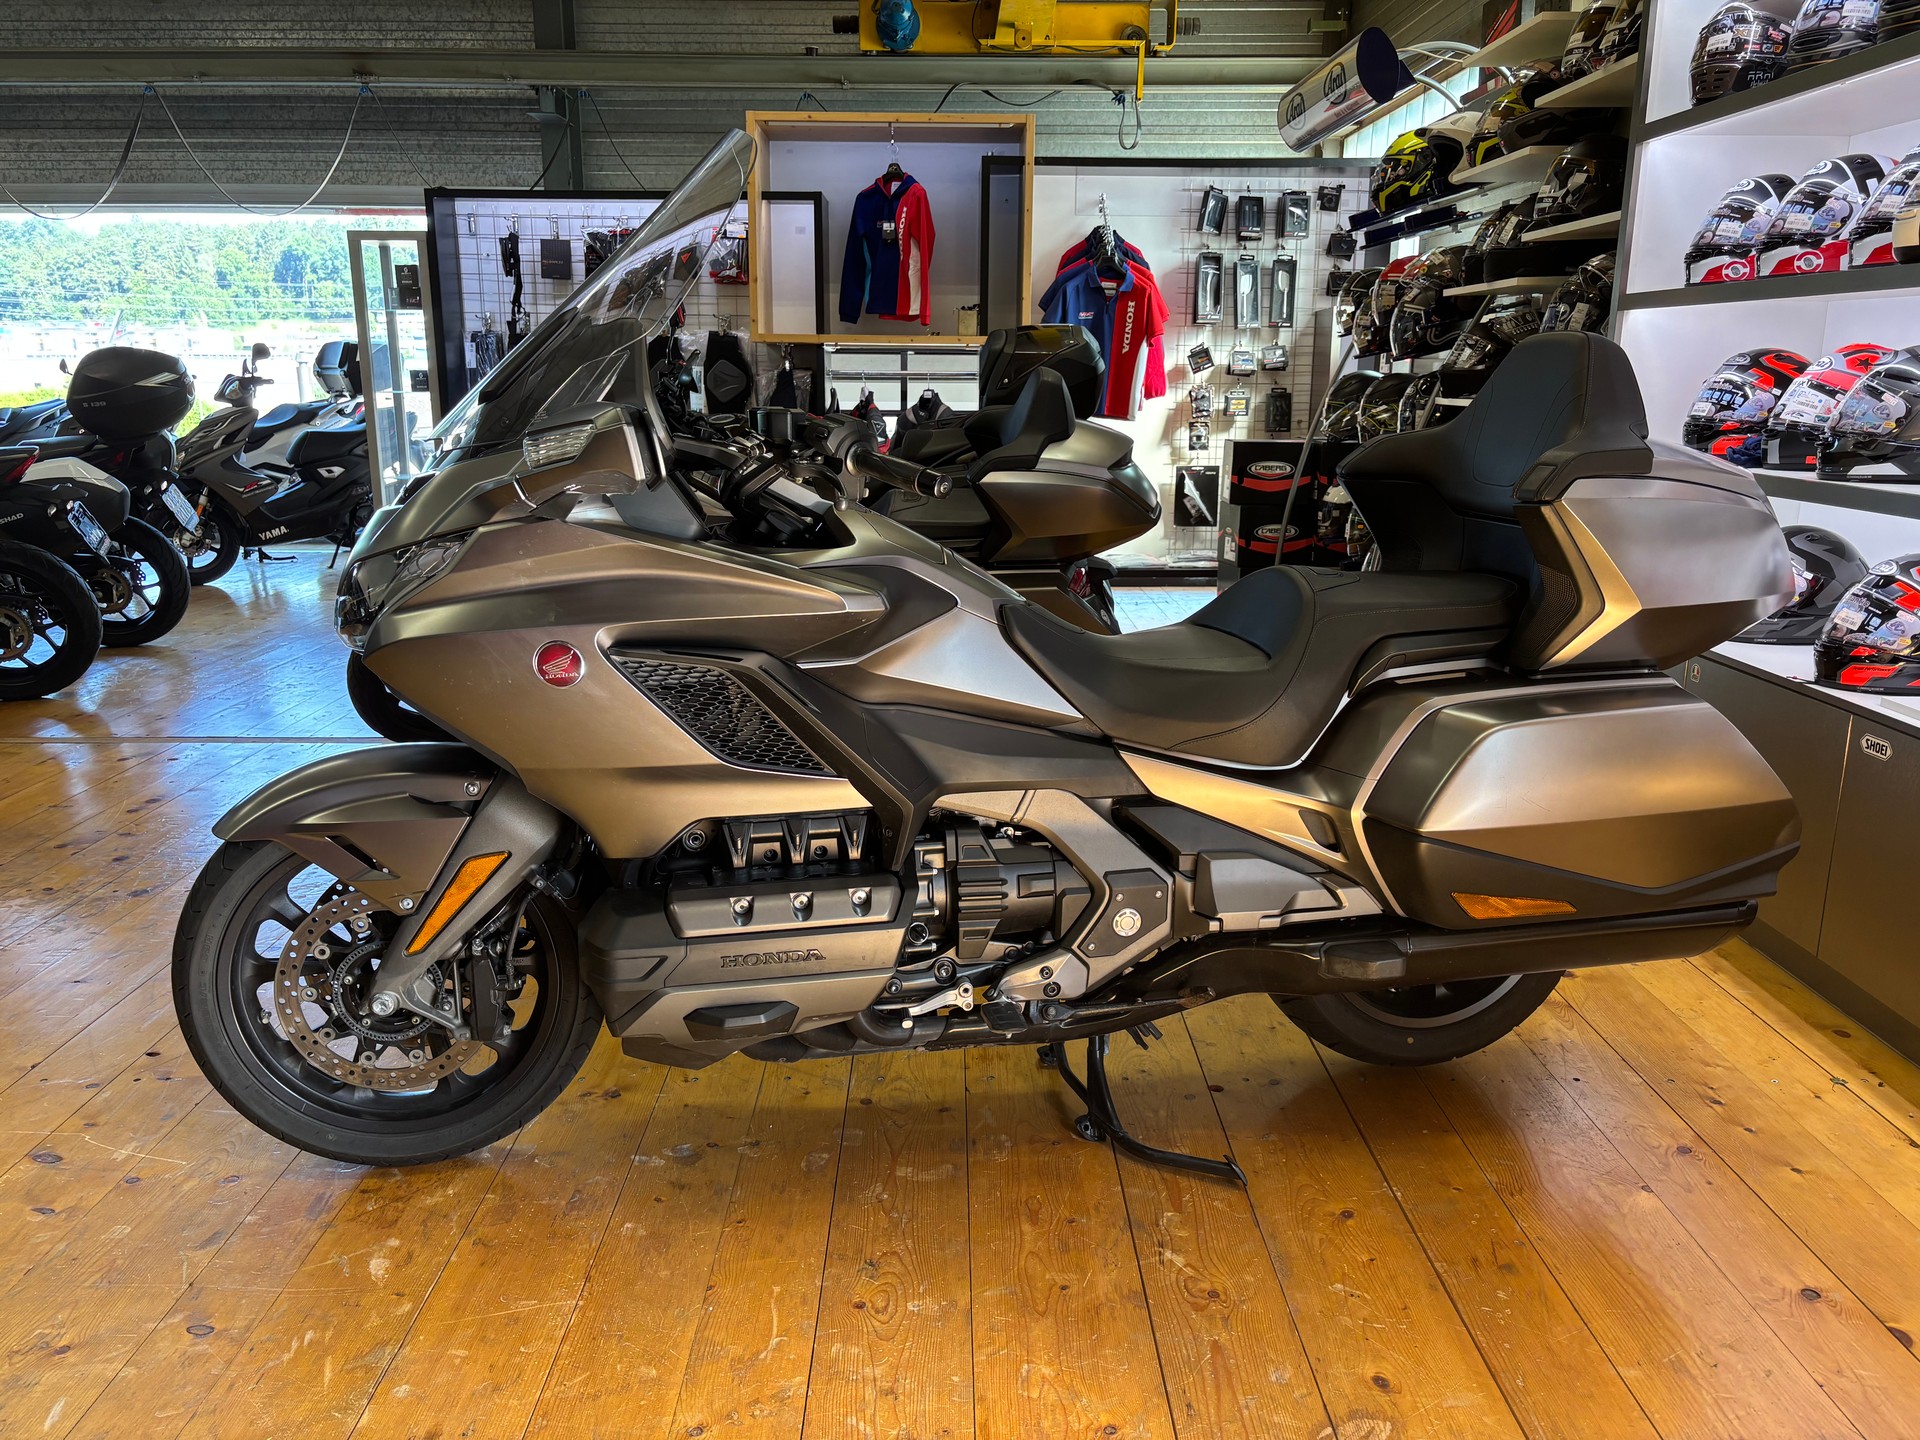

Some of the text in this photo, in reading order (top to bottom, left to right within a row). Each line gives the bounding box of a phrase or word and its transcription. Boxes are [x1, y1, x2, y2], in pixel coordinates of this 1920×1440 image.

[1327, 67, 1346, 98] Arai
[1288, 99, 1306, 124] Arai
[899, 206, 907, 261] HONDA
[1121, 300, 1136, 355] HONDA
[1254, 464, 1288, 472] CABERG
[1864, 738, 1889, 757] SHOEI
[720, 948, 827, 969] HONDA
